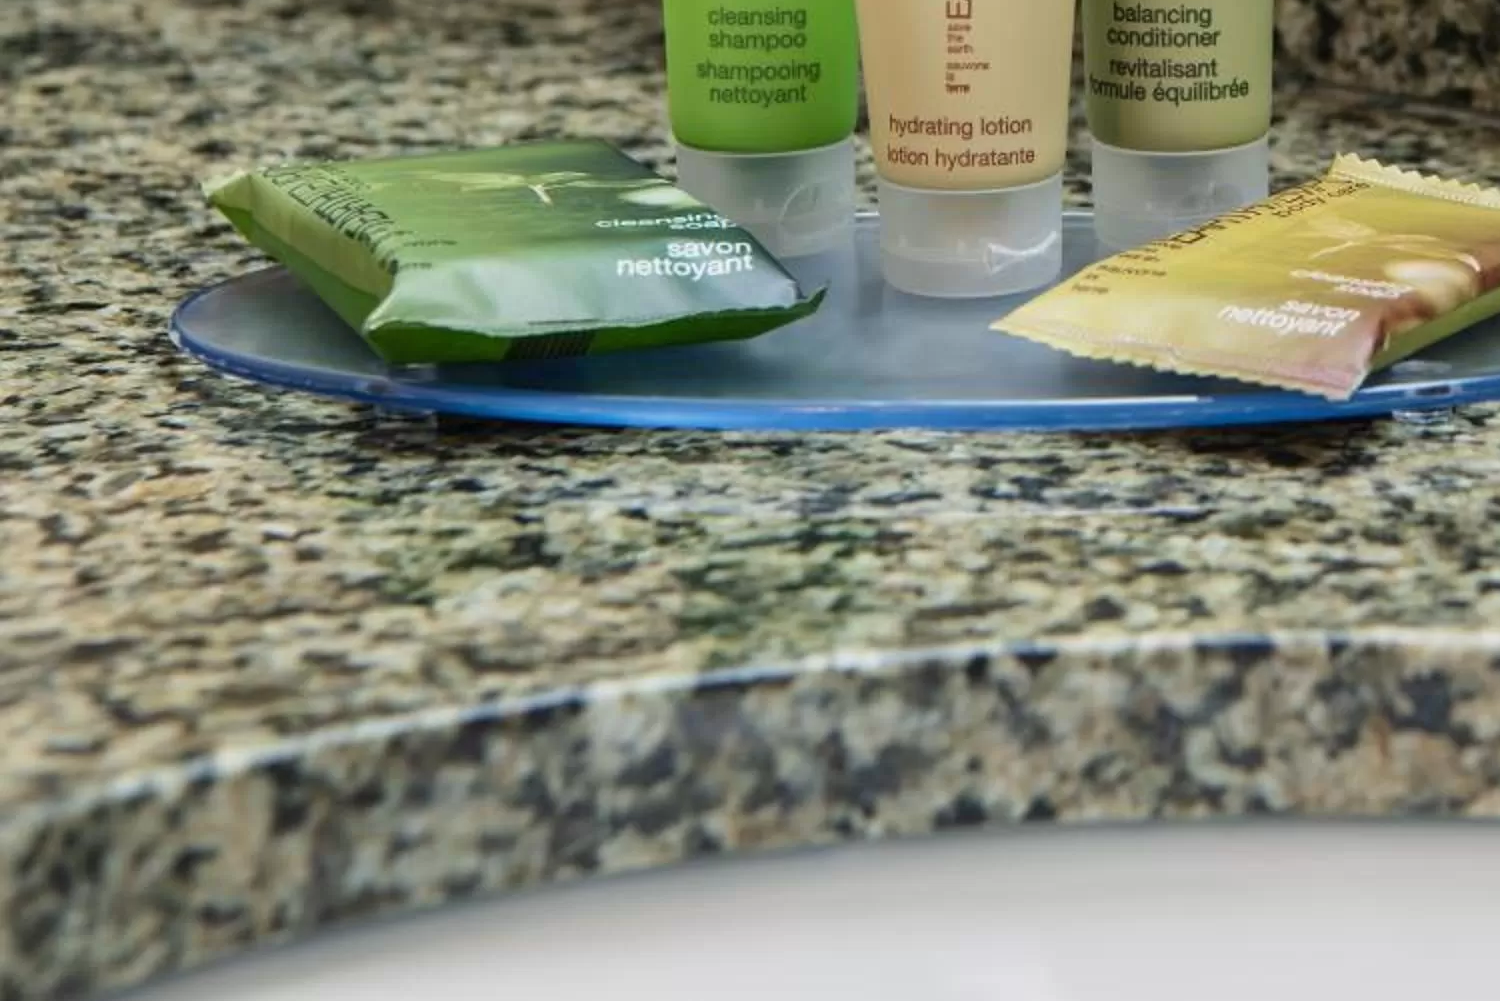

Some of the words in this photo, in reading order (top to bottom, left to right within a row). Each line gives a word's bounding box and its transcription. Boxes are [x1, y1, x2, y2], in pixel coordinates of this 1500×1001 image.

[707, 6, 807, 29] cleansing
[1113, 1, 1212, 28] balancing
[708, 29, 807, 52] shampoo
[1106, 27, 1221, 48] conditioner
[696, 58, 821, 83] shampooing
[1109, 57, 1218, 78] revitalisant
[709, 84, 808, 108] nettoyant
[1152, 78, 1249, 107] équilibrée
[889, 114, 973, 140] hydrating
[981, 116, 1032, 136] lotion
[887, 143, 928, 166] lotion
[935, 147, 1035, 171] hydratante
[667, 242, 752, 257] savon
[616, 255, 753, 281] nettoyant
[1218, 305, 1346, 337] nettoyant
[1280, 300, 1360, 321] savon
